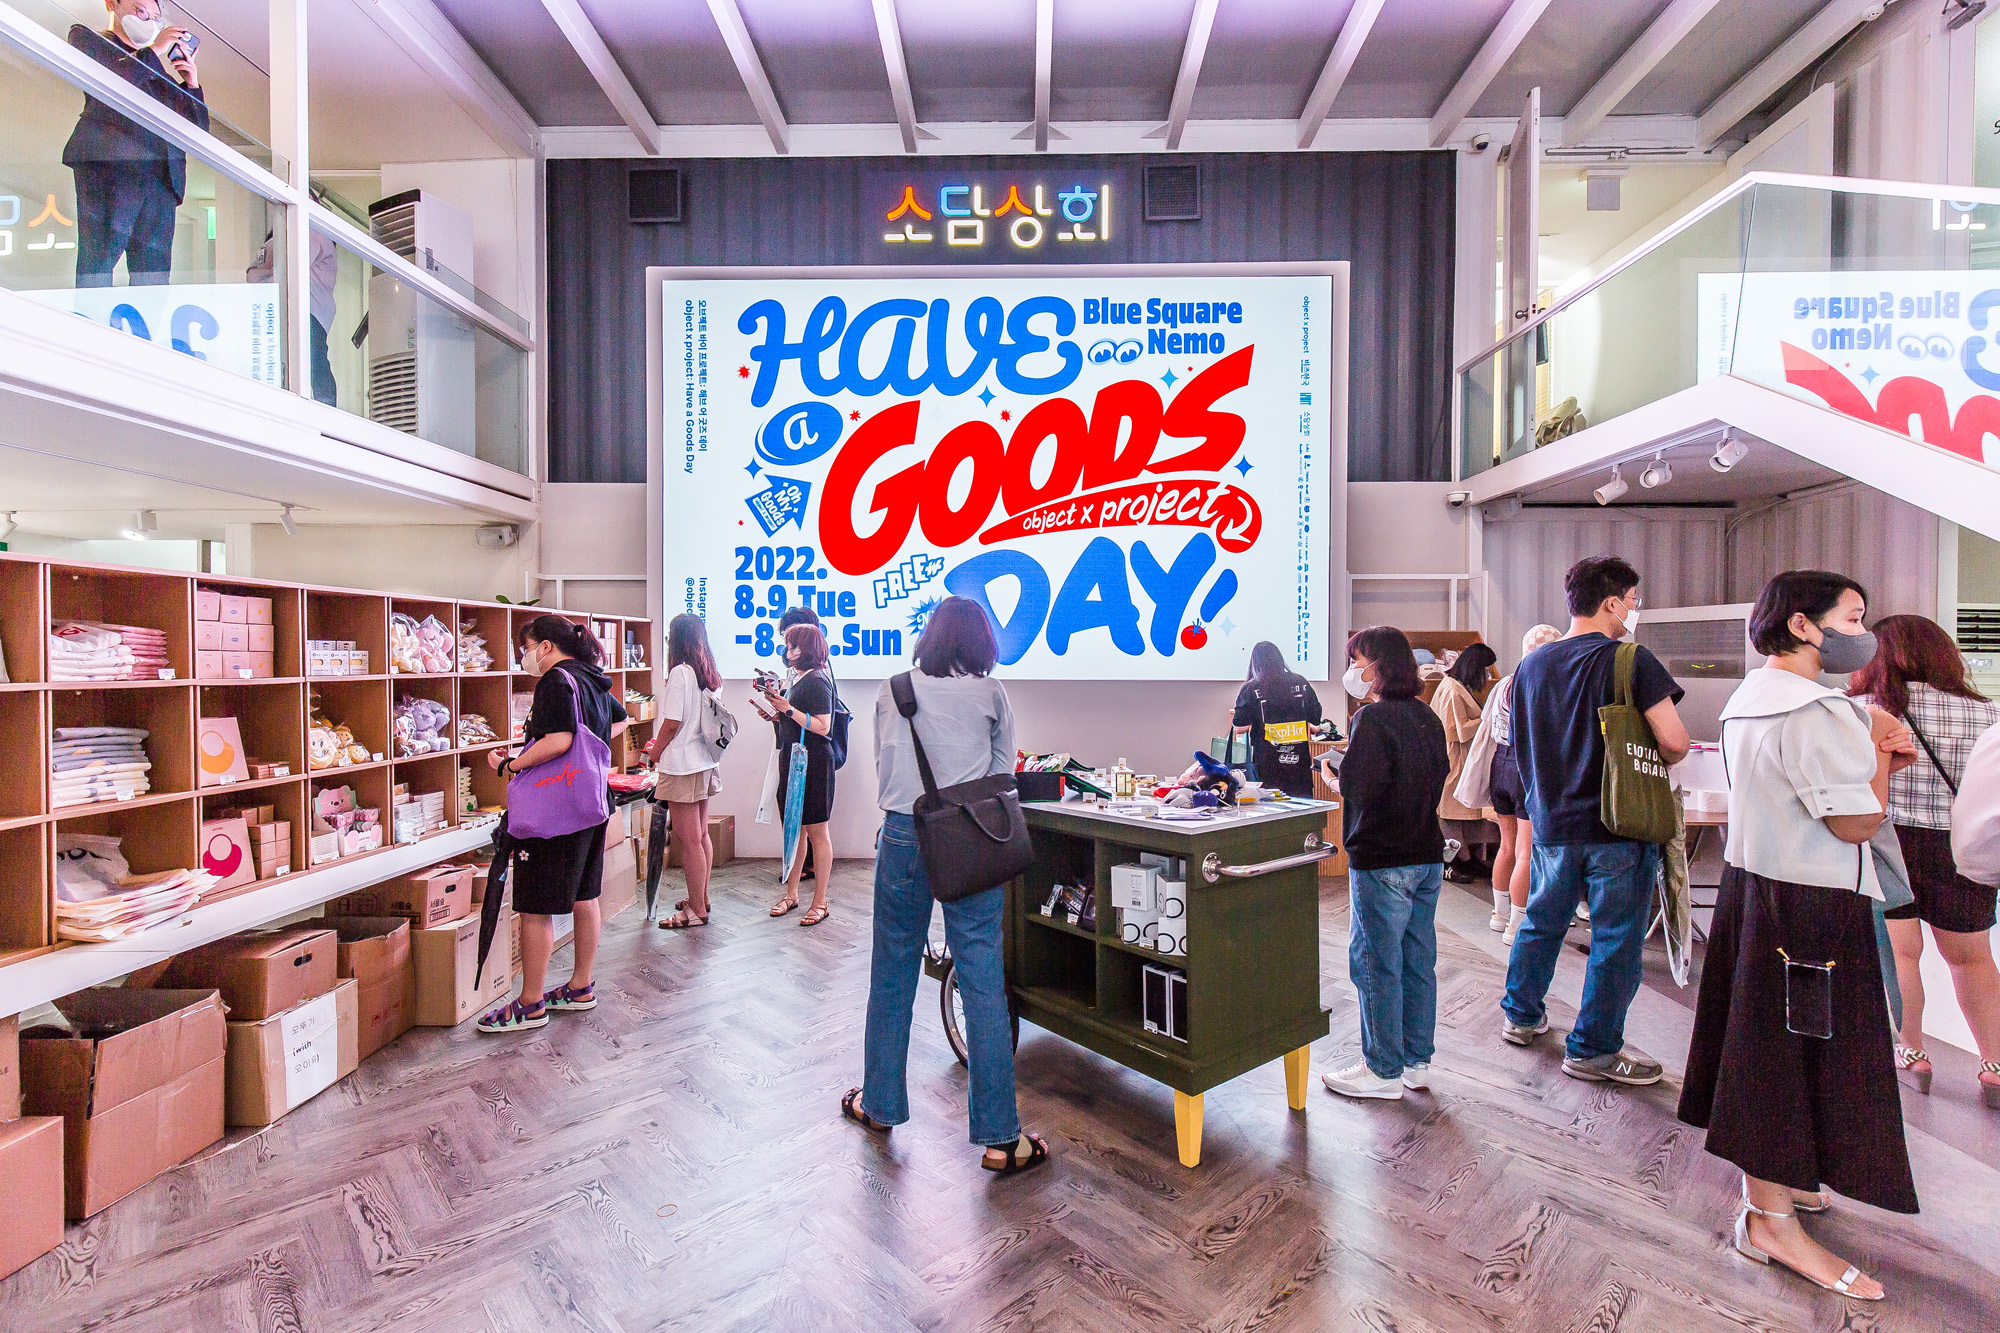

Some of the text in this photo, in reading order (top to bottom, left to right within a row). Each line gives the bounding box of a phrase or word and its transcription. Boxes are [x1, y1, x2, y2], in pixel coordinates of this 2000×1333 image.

[884, 185, 1110, 248] 소담상회
[684, 299, 695, 332] object
[1083, 297, 1243, 329] Blue Square
[1302, 296, 1310, 320] object
[698, 334, 708, 350] 바이
[1148, 328, 1225, 354] Nemo
[1301, 327, 1310, 354] project
[684, 341, 695, 381] project:
[685, 383, 695, 408] Have
[685, 419, 695, 452] Goods
[683, 455, 695, 474] Day
[818, 343, 1255, 577] GOODS
[760, 491, 785, 526] Goods
[774, 489, 792, 512] My
[786, 485, 802, 504] Oh
[1022, 482, 1231, 533] object x project
[734, 546, 828, 581] 2022.
[697, 577, 707, 625] Instagra
